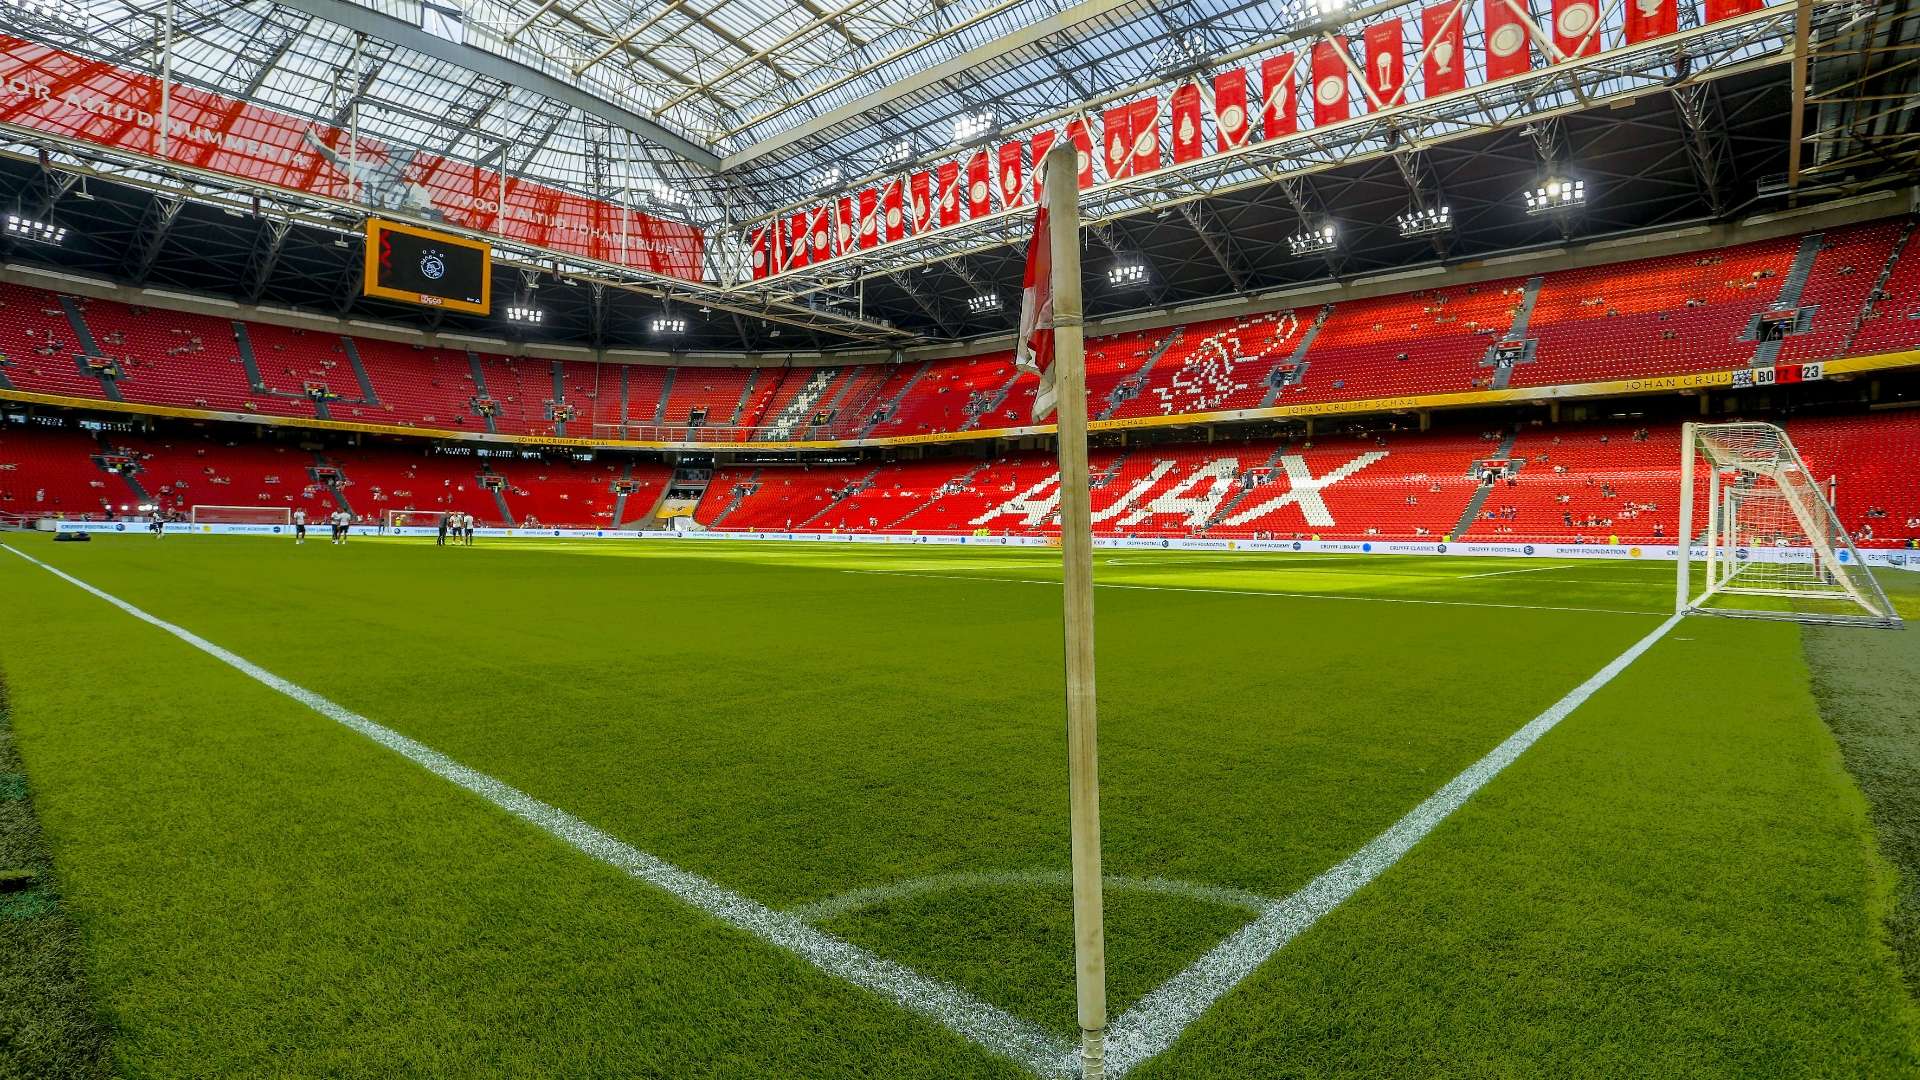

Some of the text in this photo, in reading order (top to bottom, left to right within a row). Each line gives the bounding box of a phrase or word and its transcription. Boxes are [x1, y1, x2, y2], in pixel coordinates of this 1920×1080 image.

[1626, 374, 1731, 391] JOHAN CRUIJ
[1287, 399, 1419, 415] JOHAN CRUIJFF SCHAAL
[967, 450, 1390, 527] AJAX
